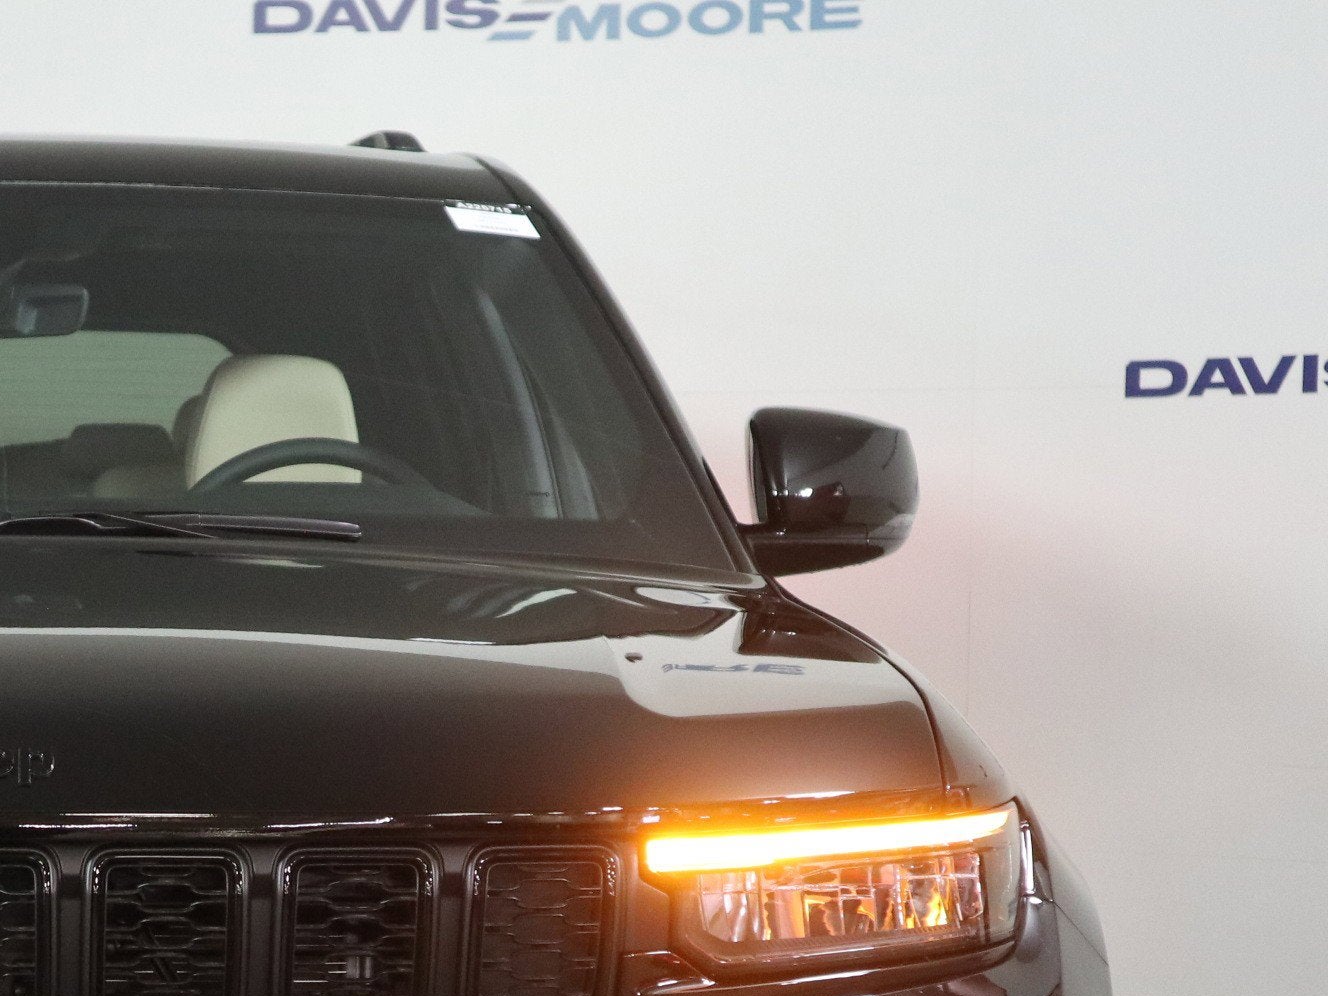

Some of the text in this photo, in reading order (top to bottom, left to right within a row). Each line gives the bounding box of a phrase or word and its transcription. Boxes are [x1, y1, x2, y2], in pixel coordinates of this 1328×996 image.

[252, 0, 863, 42] DAVIS MOORE
[1124, 354, 1328, 398] DAVI
